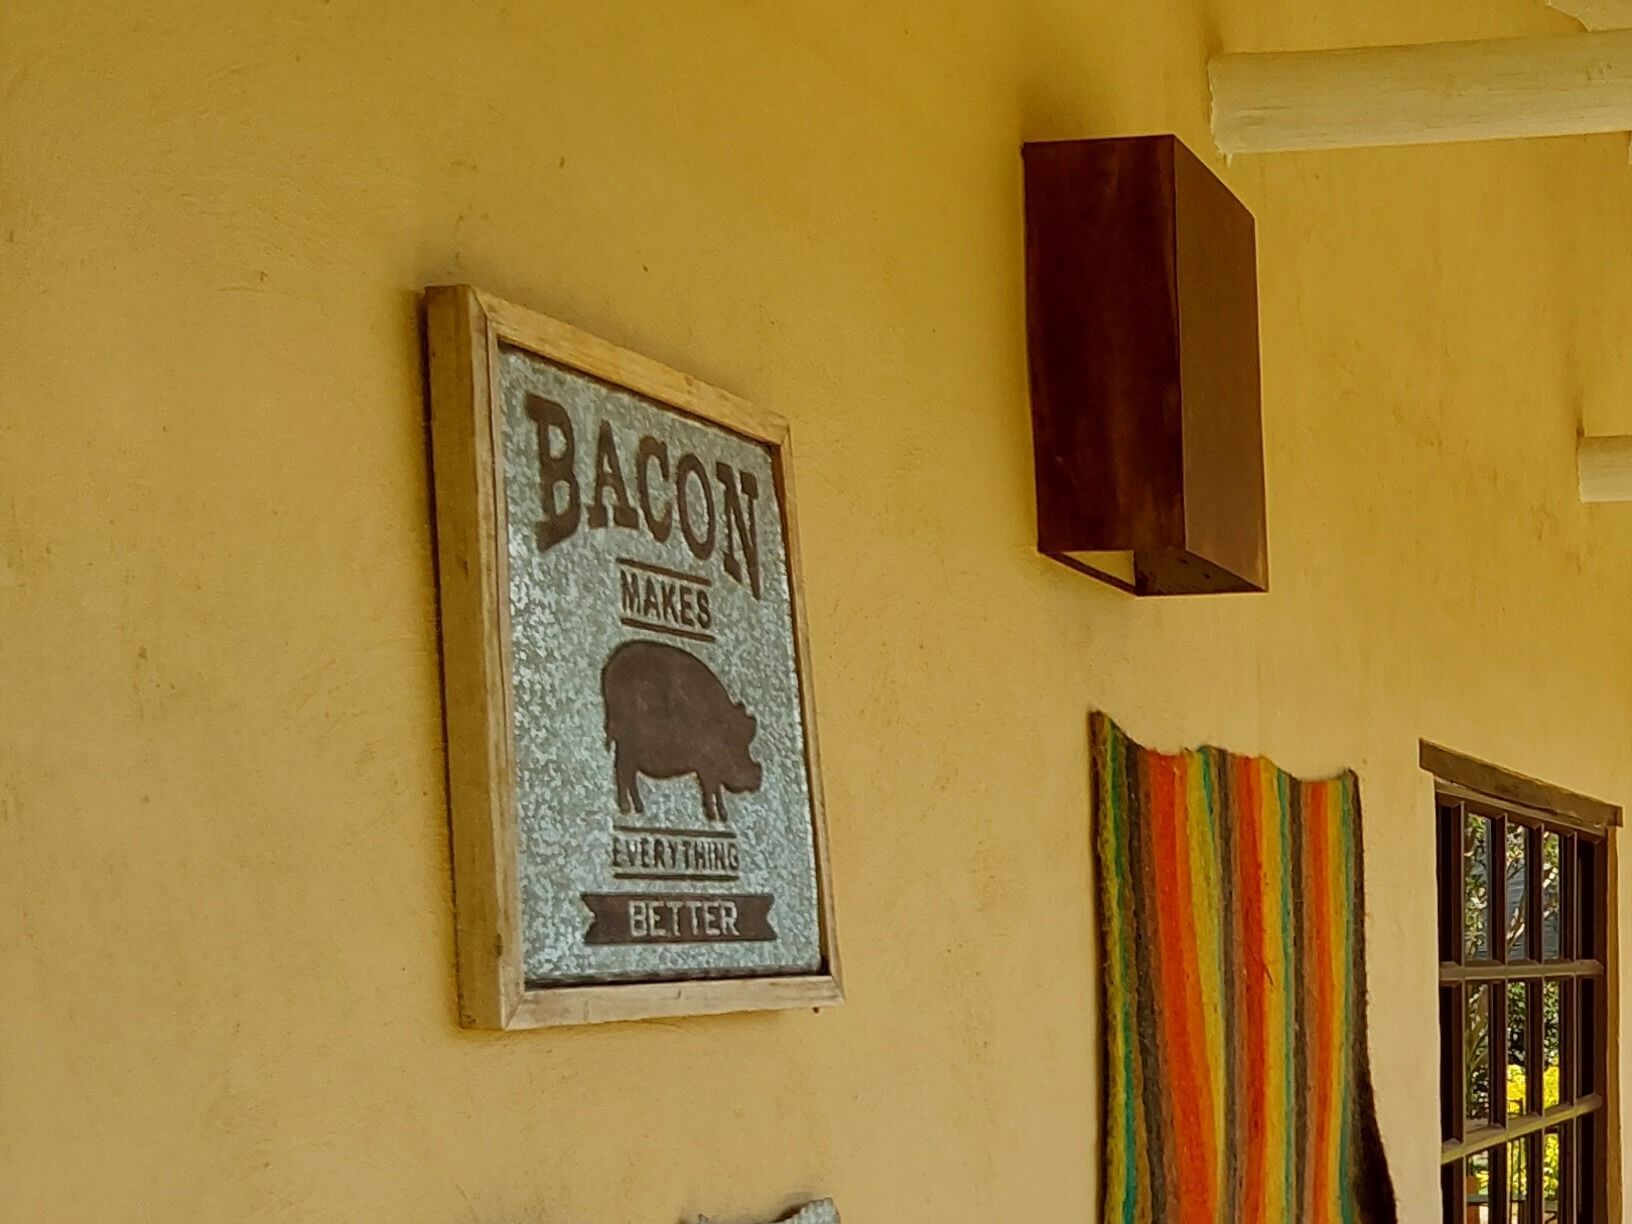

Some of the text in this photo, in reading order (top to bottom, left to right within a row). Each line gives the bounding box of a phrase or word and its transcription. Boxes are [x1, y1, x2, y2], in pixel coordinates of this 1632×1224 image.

[526, 394, 761, 600] BACON
[620, 570, 712, 629] MAKES
[612, 837, 740, 873] EVERYTHING
[629, 900, 740, 938] BETTER
